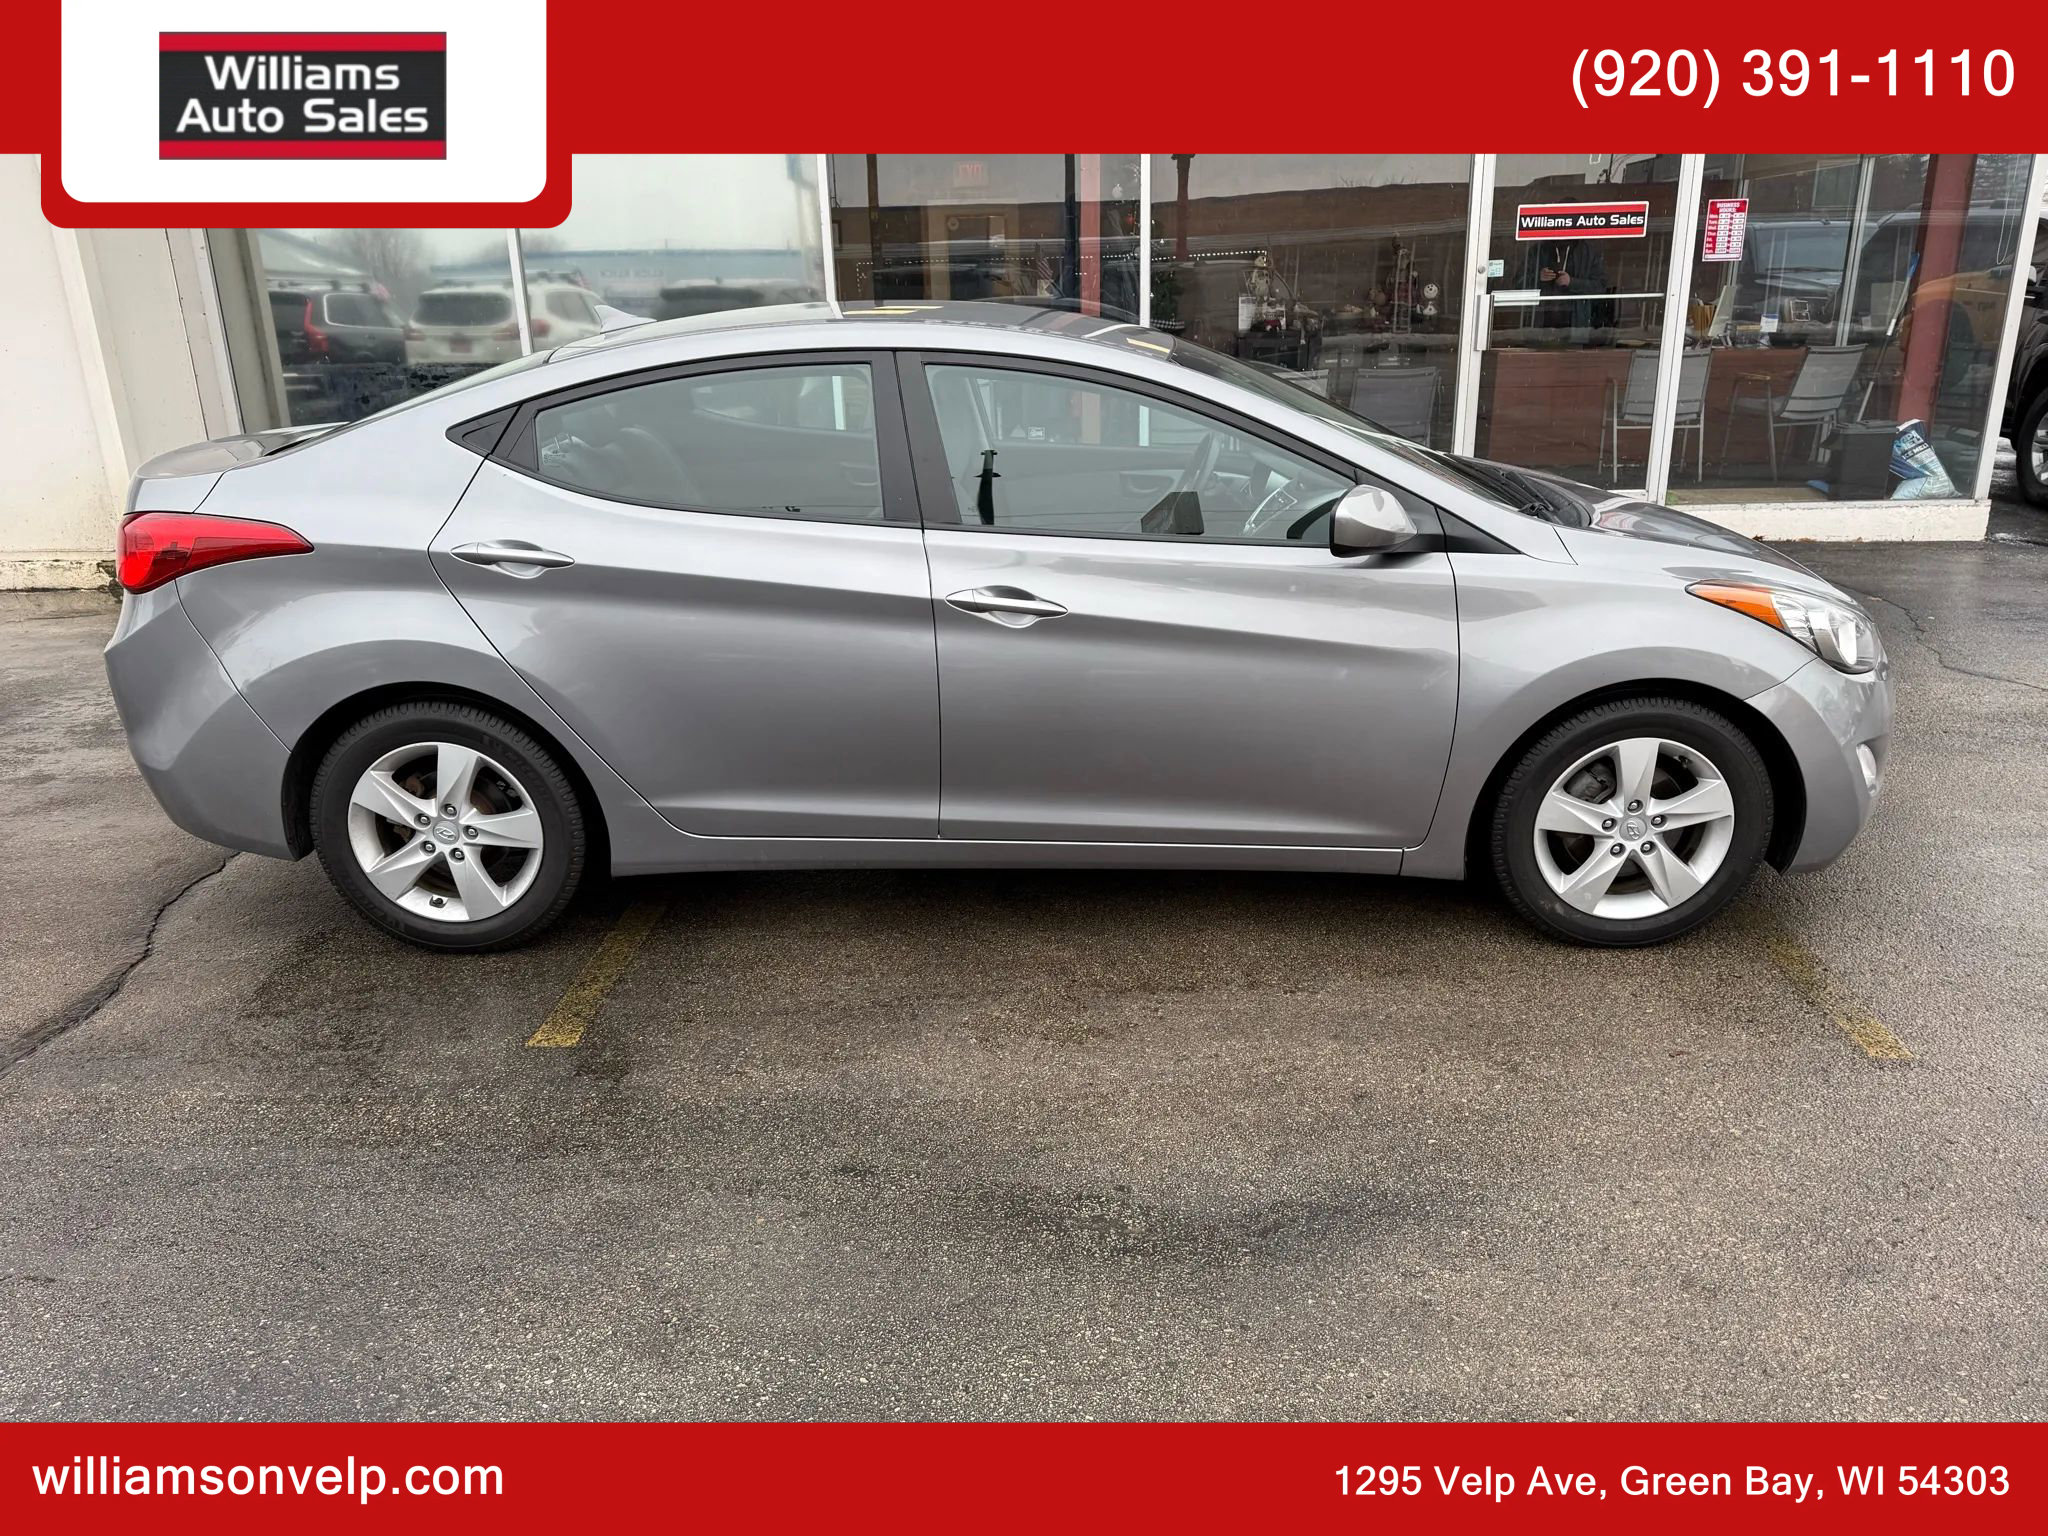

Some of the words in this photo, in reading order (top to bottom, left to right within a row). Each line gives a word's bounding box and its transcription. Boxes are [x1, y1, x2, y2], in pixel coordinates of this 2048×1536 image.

[1521, 215, 1573, 228] Williams
[1576, 215, 1606, 227] Auto
[1610, 213, 1644, 226] Sales
